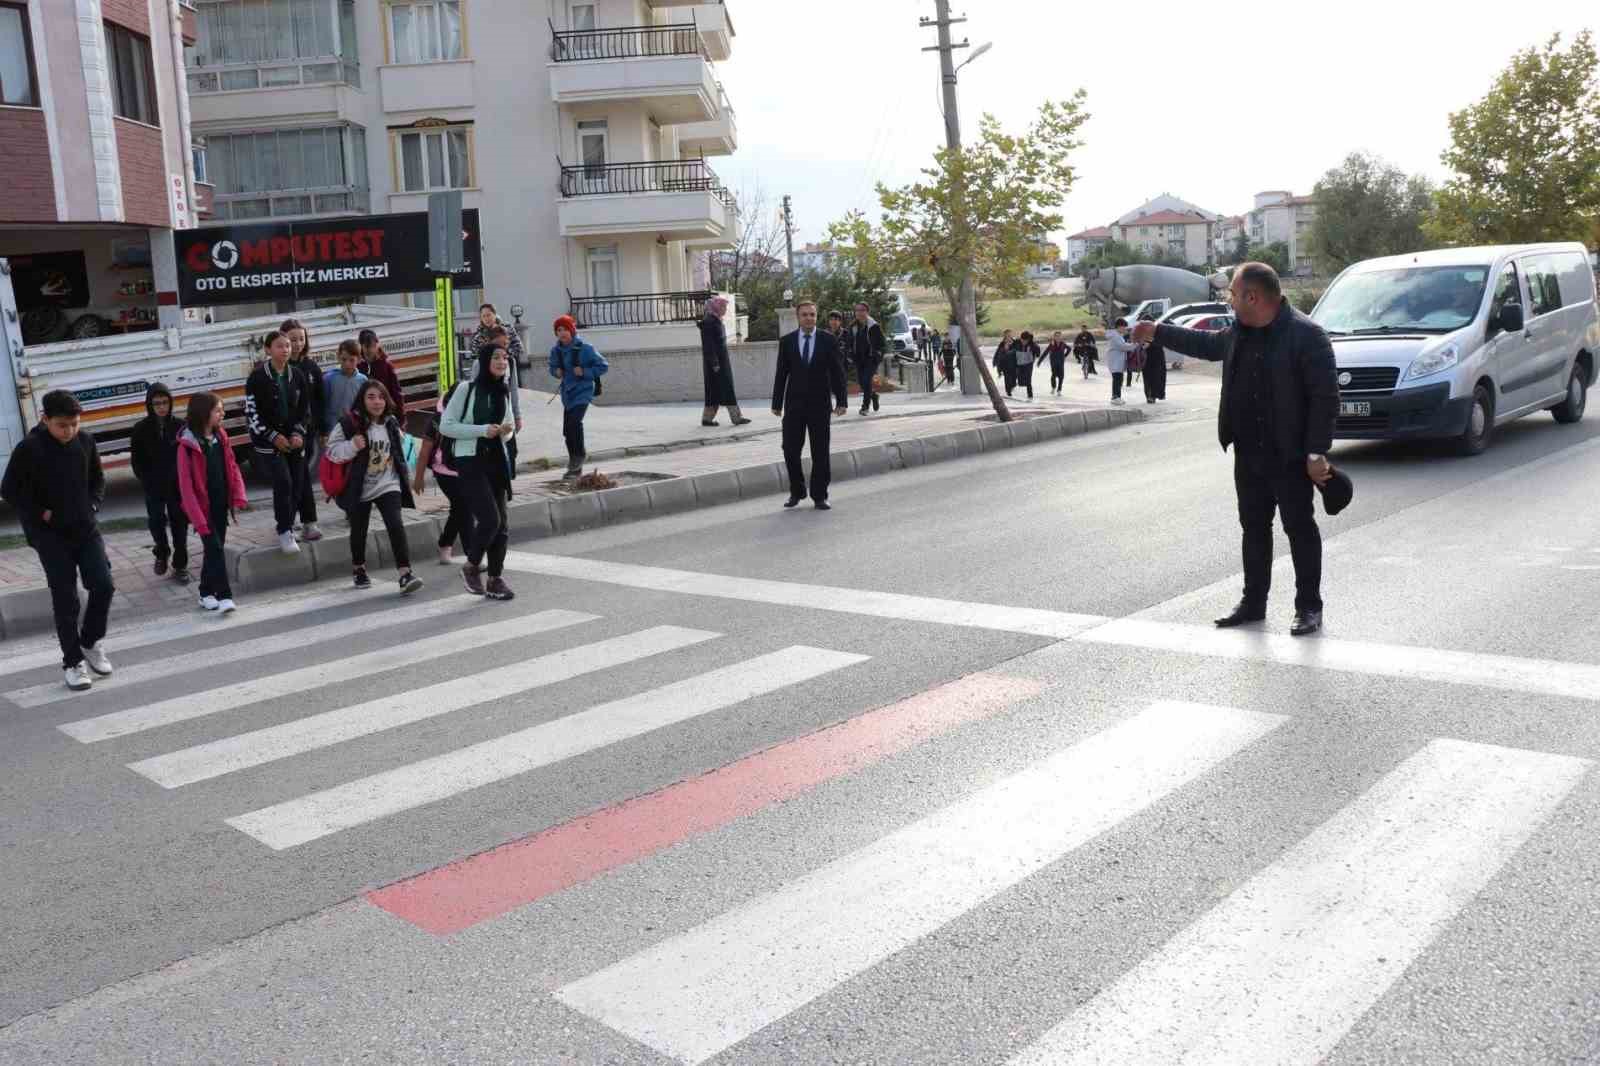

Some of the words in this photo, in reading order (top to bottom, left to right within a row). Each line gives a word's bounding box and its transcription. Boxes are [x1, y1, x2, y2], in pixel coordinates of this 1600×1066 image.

[186, 229, 385, 272] COMPUTEST
[195, 276, 227, 291] OTO
[230, 267, 318, 289] EKSPERTİZ
[317, 262, 390, 283] MERKEZİ
